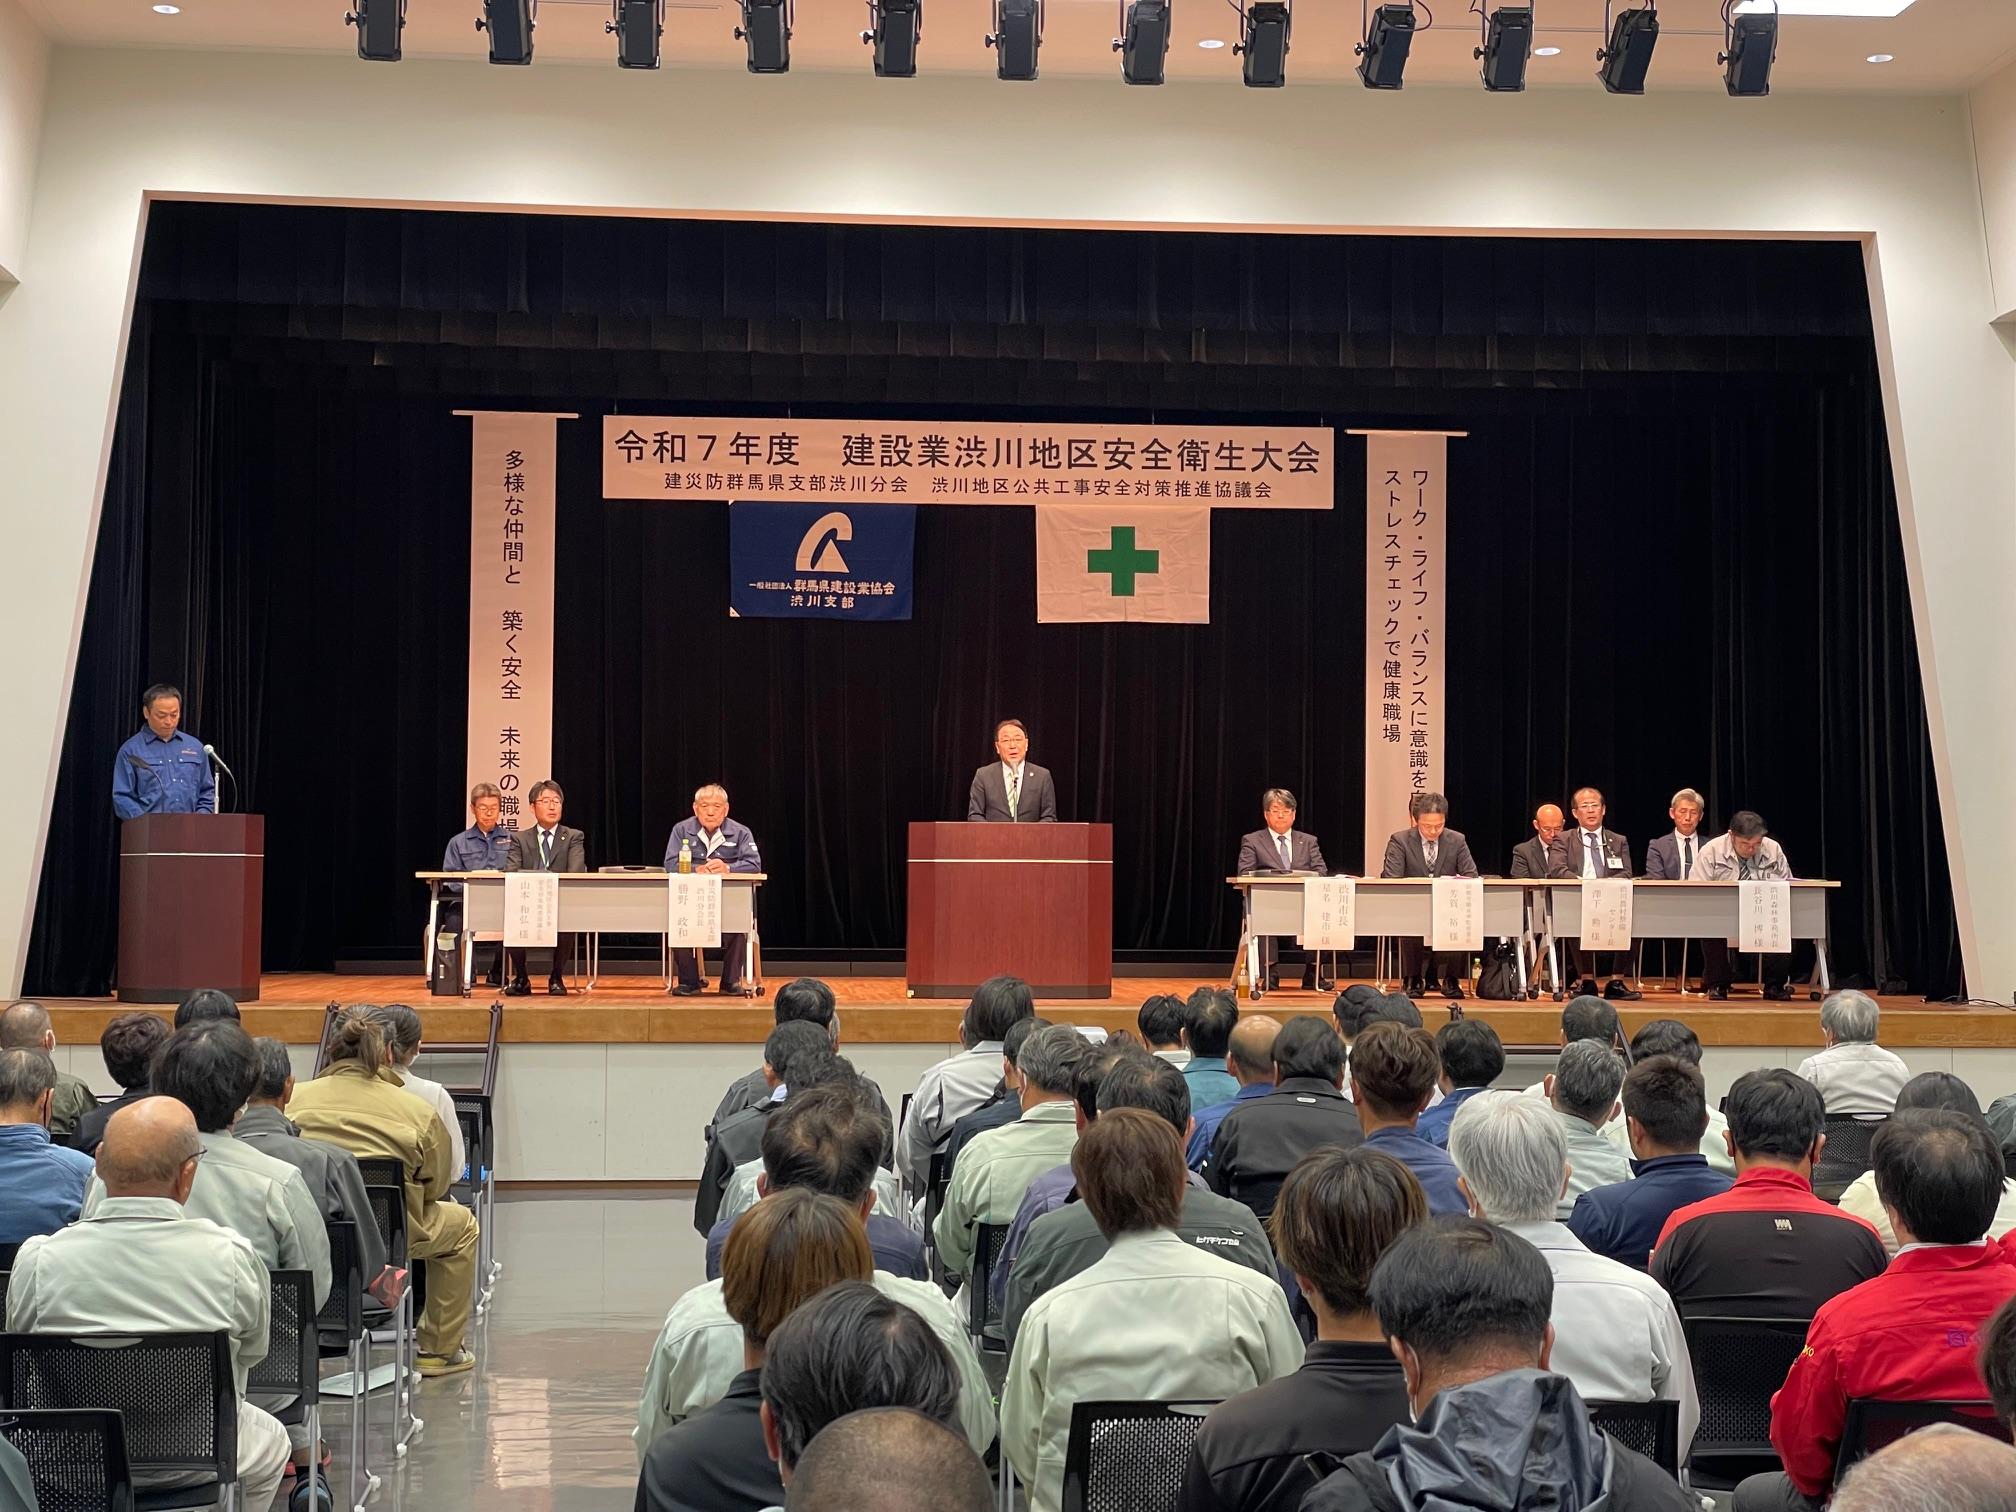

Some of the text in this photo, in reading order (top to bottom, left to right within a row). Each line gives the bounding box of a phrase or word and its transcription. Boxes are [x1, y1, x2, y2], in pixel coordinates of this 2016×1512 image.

[614, 429, 1320, 474] 令和7年度 建設業渋川地区安全衛生大会
[664, 472, 1272, 497] 建災防群馬県支部渋川分会 渋川地区公共工事安全対策推進協議会
[503, 449, 525, 584] 多様な仲間と
[790, 594, 855, 609] 渋川支部
[1382, 470, 1402, 743] ストレスチェックで健康職場
[500, 609, 522, 700] 築く安全
[1338, 884, 1350, 927] 渋川市長
